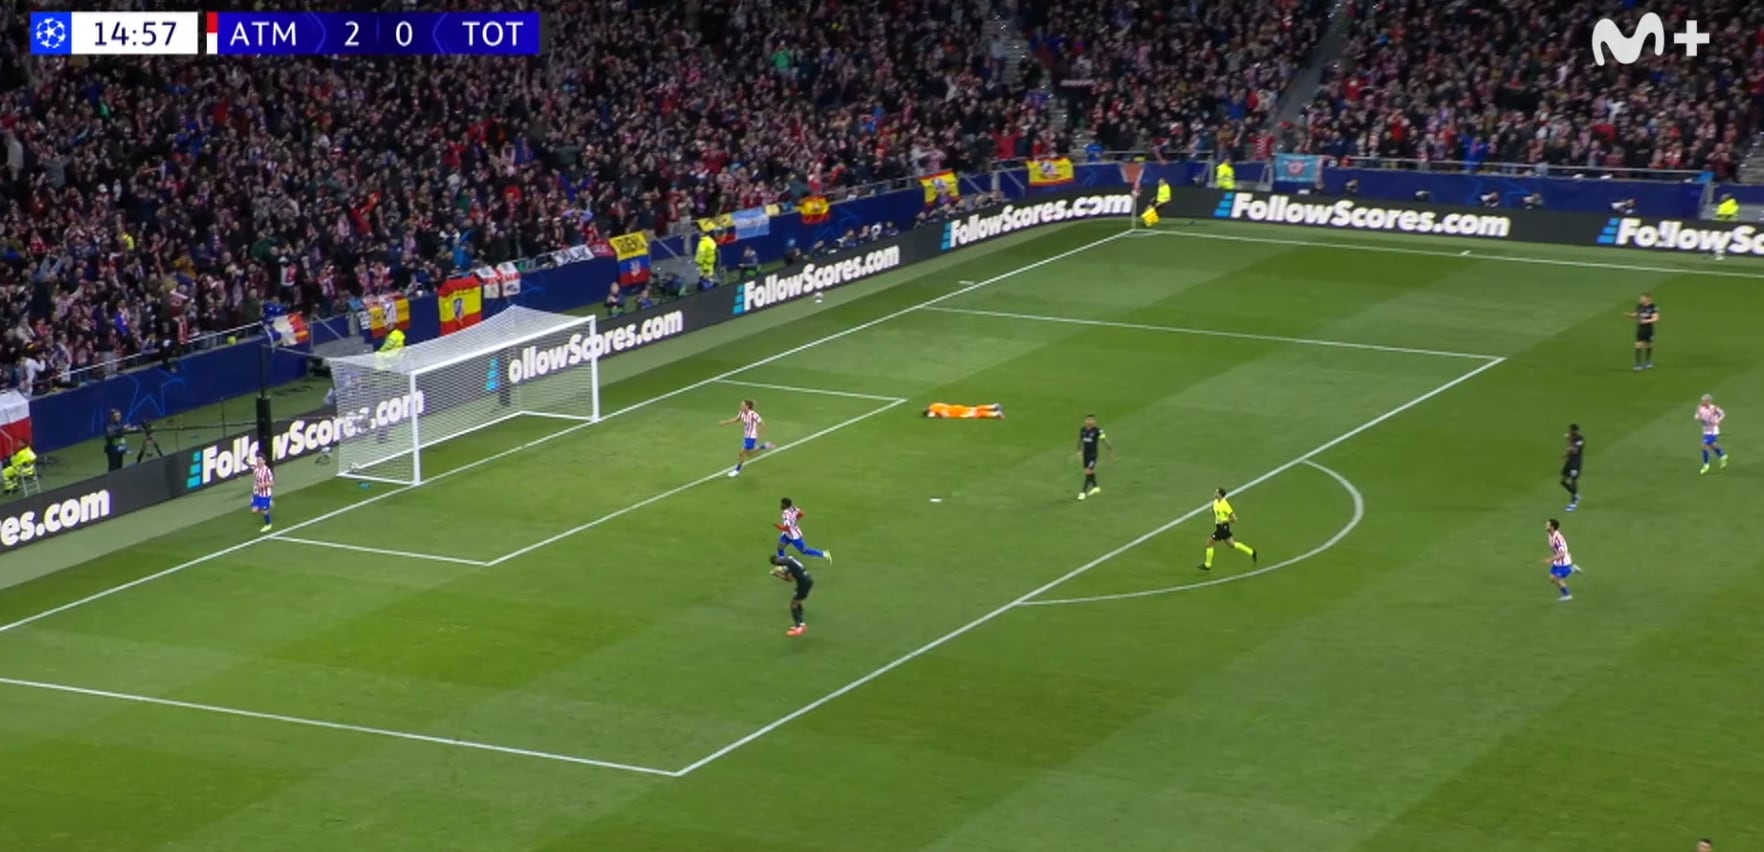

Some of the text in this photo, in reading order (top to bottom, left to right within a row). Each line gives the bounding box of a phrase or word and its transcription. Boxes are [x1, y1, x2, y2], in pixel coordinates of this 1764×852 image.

[949, 193, 1133, 247] FollowScores.com
[1230, 189, 1510, 237] FollowScores.com
[744, 245, 900, 311] FollowScores.com
[507, 310, 684, 384] ollowScores.com
[0, 490, 110, 546] es.com
